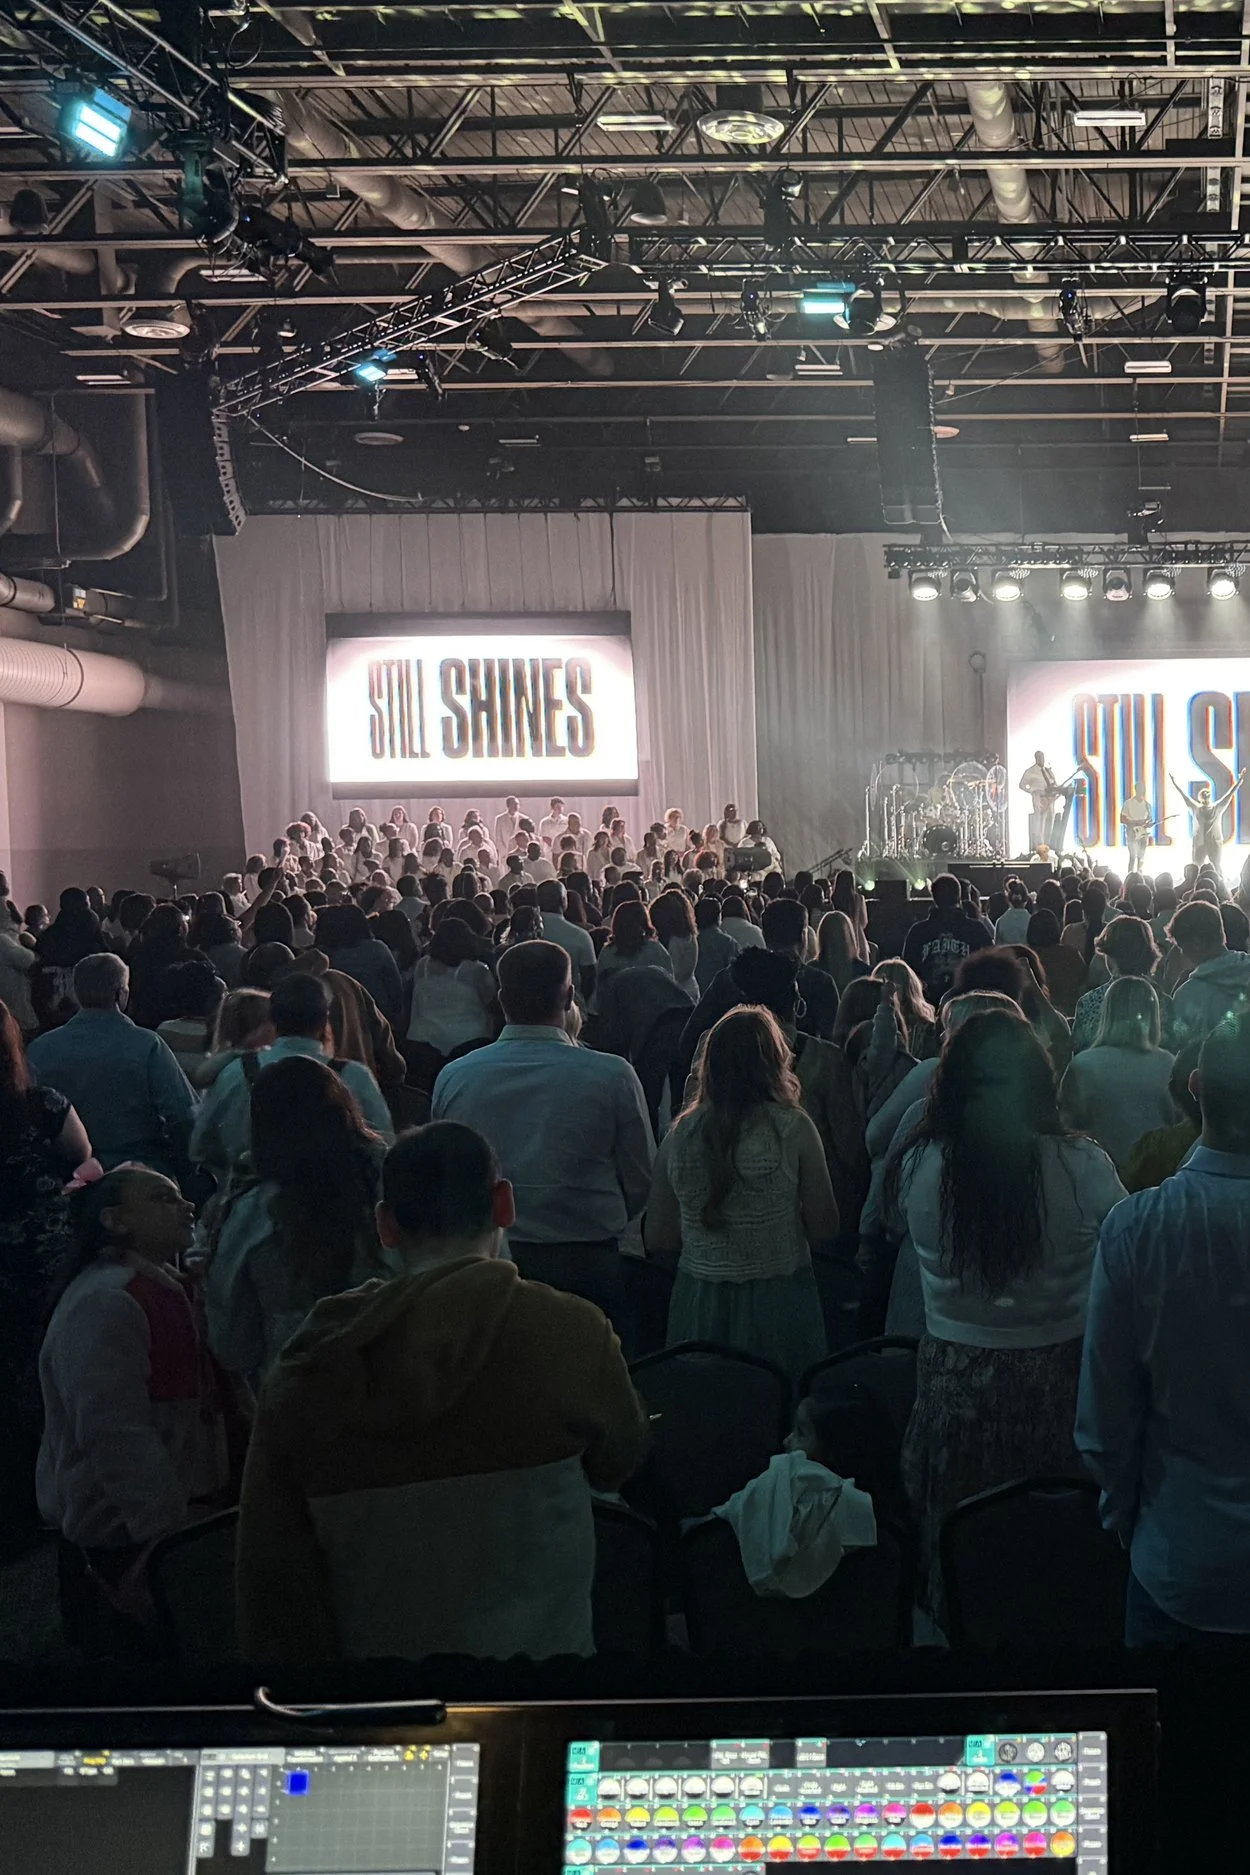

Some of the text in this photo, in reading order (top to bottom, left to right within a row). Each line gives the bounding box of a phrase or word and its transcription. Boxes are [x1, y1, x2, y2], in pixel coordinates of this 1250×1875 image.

[367, 657, 595, 759] STILL SHINES
[1072, 693, 1172, 847] STILL
[922, 938, 970, 962] FAITH
